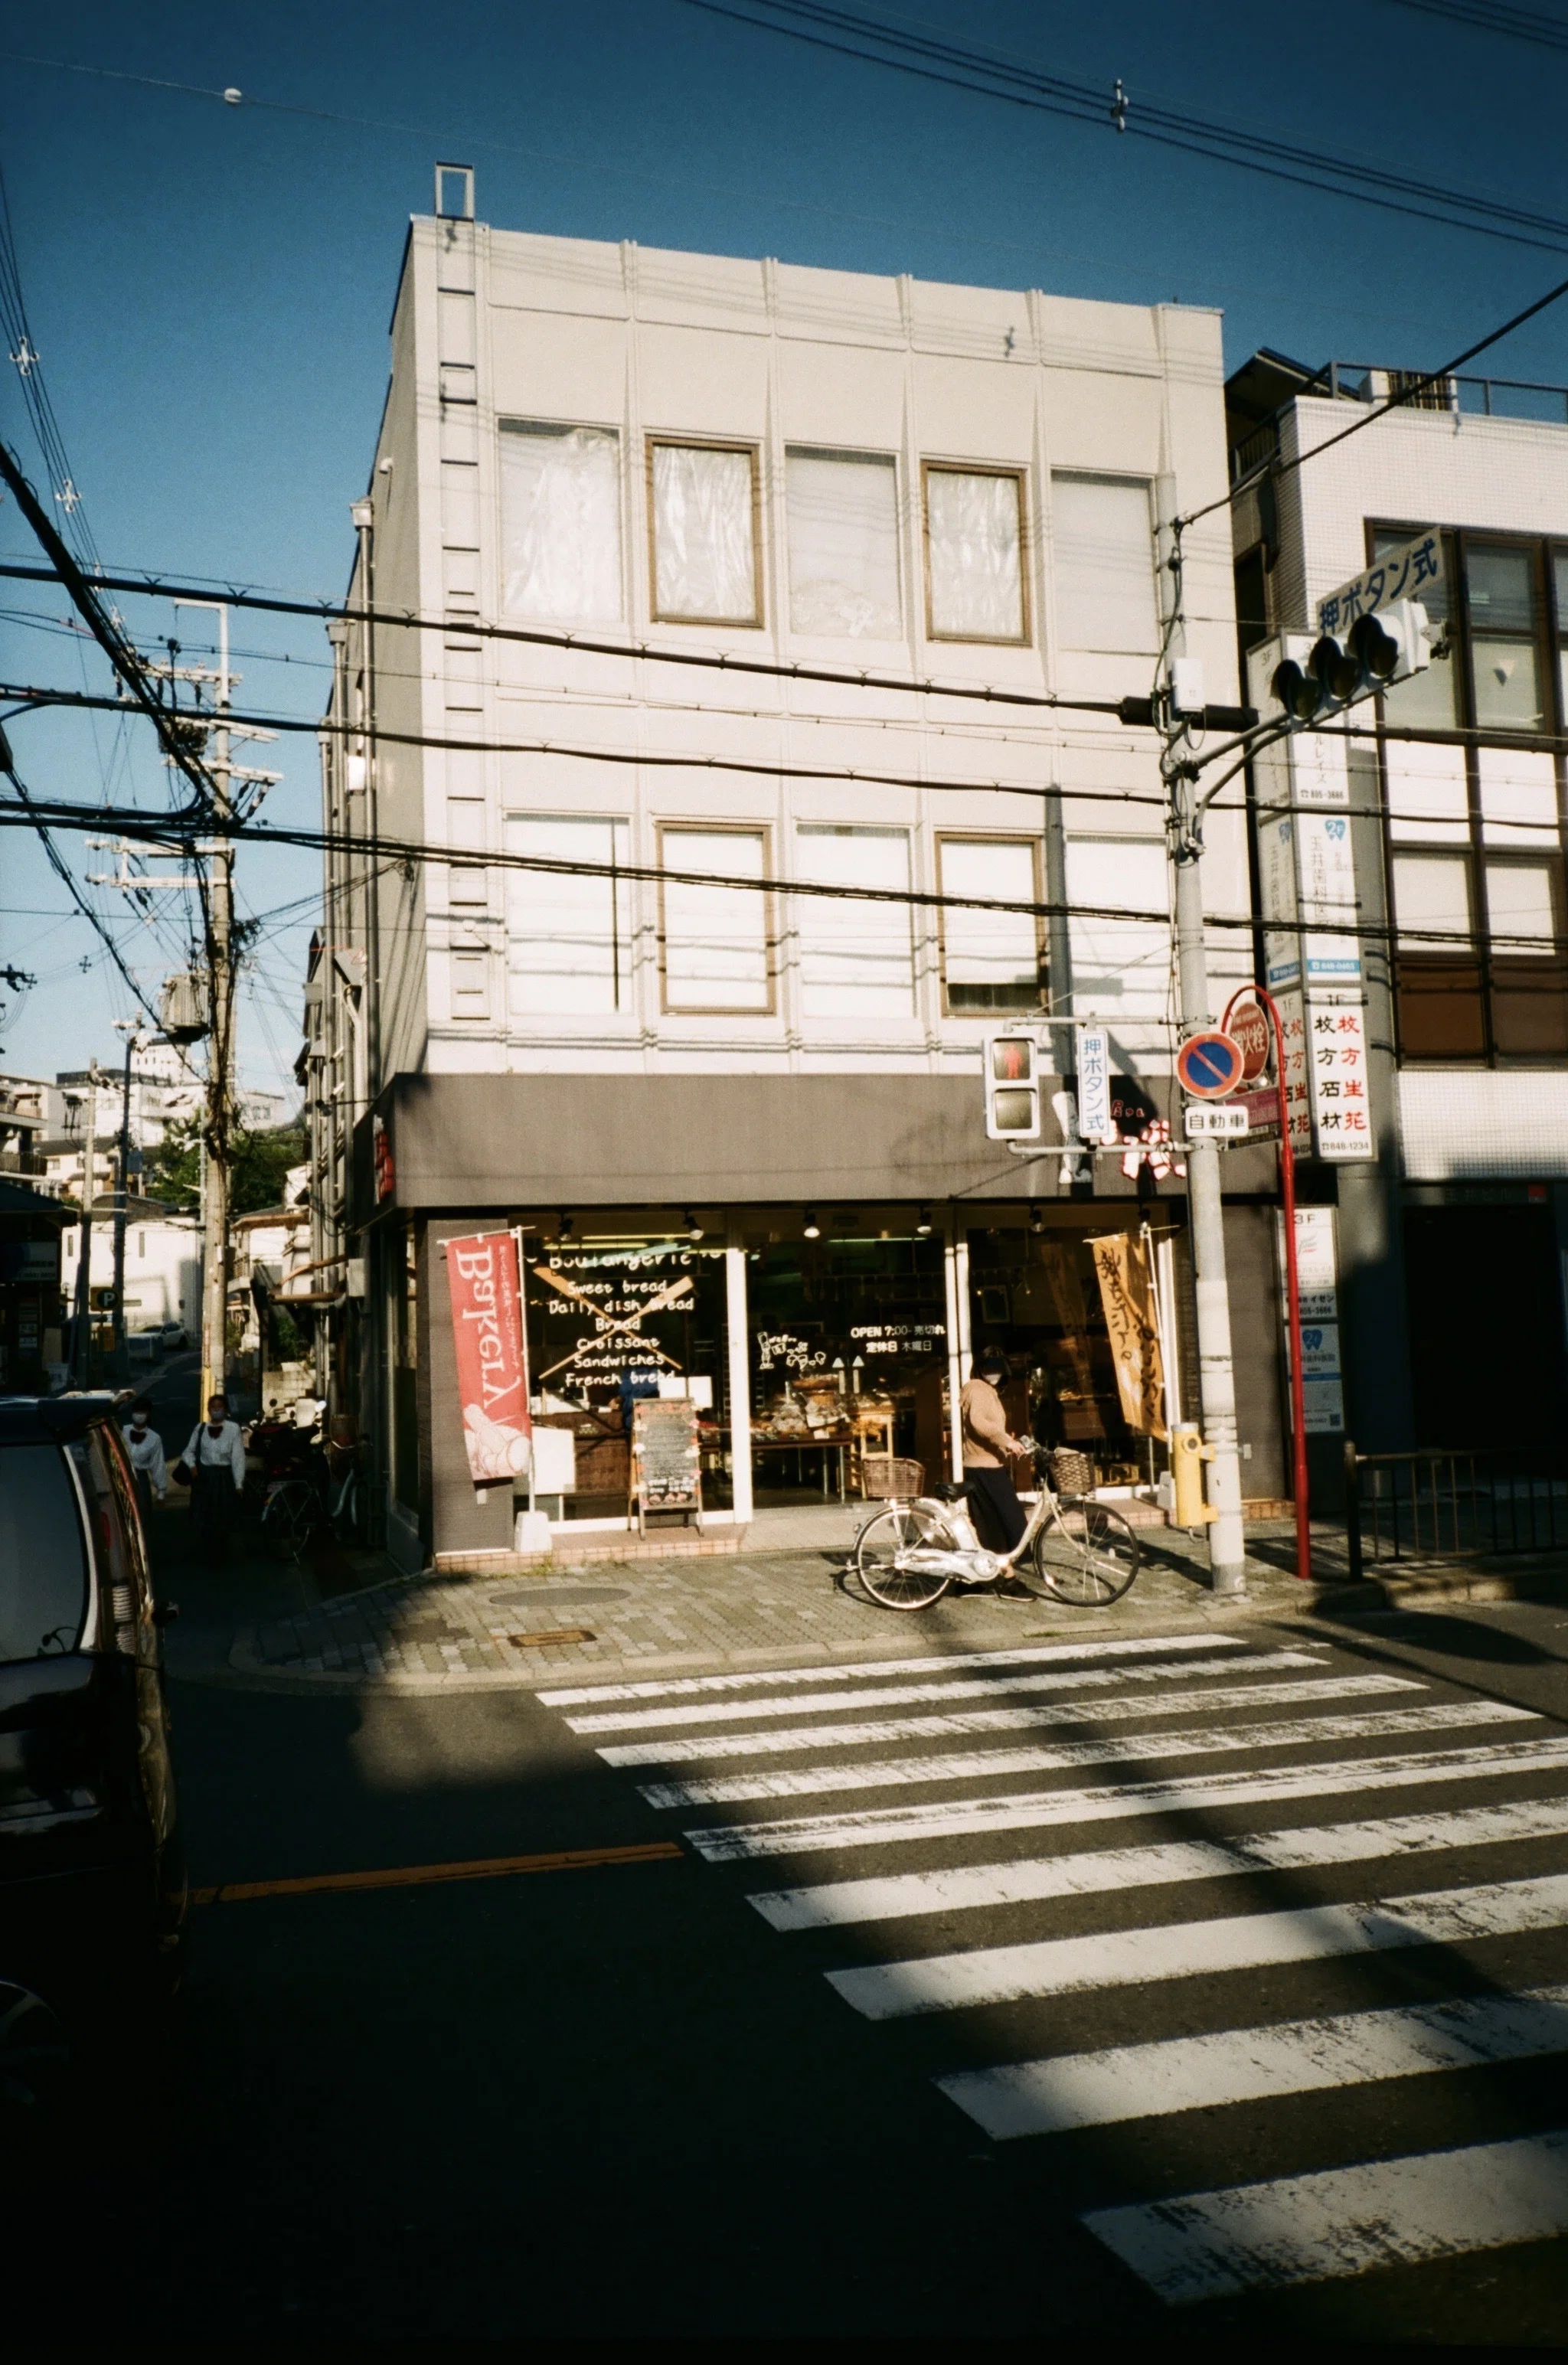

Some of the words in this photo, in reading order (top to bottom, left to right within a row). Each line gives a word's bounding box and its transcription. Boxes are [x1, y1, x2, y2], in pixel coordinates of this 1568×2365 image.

[1319, 538, 1439, 637] 押ボタン式
[1314, 1016, 1342, 1131] 枚方石材
[1337, 1016, 1367, 1131] 枚方生花
[1083, 1038, 1106, 1132] 押ボタン式
[1190, 1115, 1244, 1130] 自動車
[1331, 1141, 1369, 1151] 848-1234
[567, 1281, 612, 1295] Sweet
[622, 1279, 668, 1294] bread
[103, 1292, 116, 1307] P
[549, 1299, 596, 1316] Daily
[604, 1299, 641, 1314] dish
[595, 1317, 641, 1332] Bread
[850, 1326, 882, 1338] OPEN
[913, 1324, 946, 1336] 売切れ
[577, 1337, 661, 1350] Croissant
[865, 1340, 898, 1353] 定休日
[901, 1340, 933, 1352] 木曜日
[573, 1354, 665, 1368] Sandwiches
[565, 1372, 622, 1387] French
